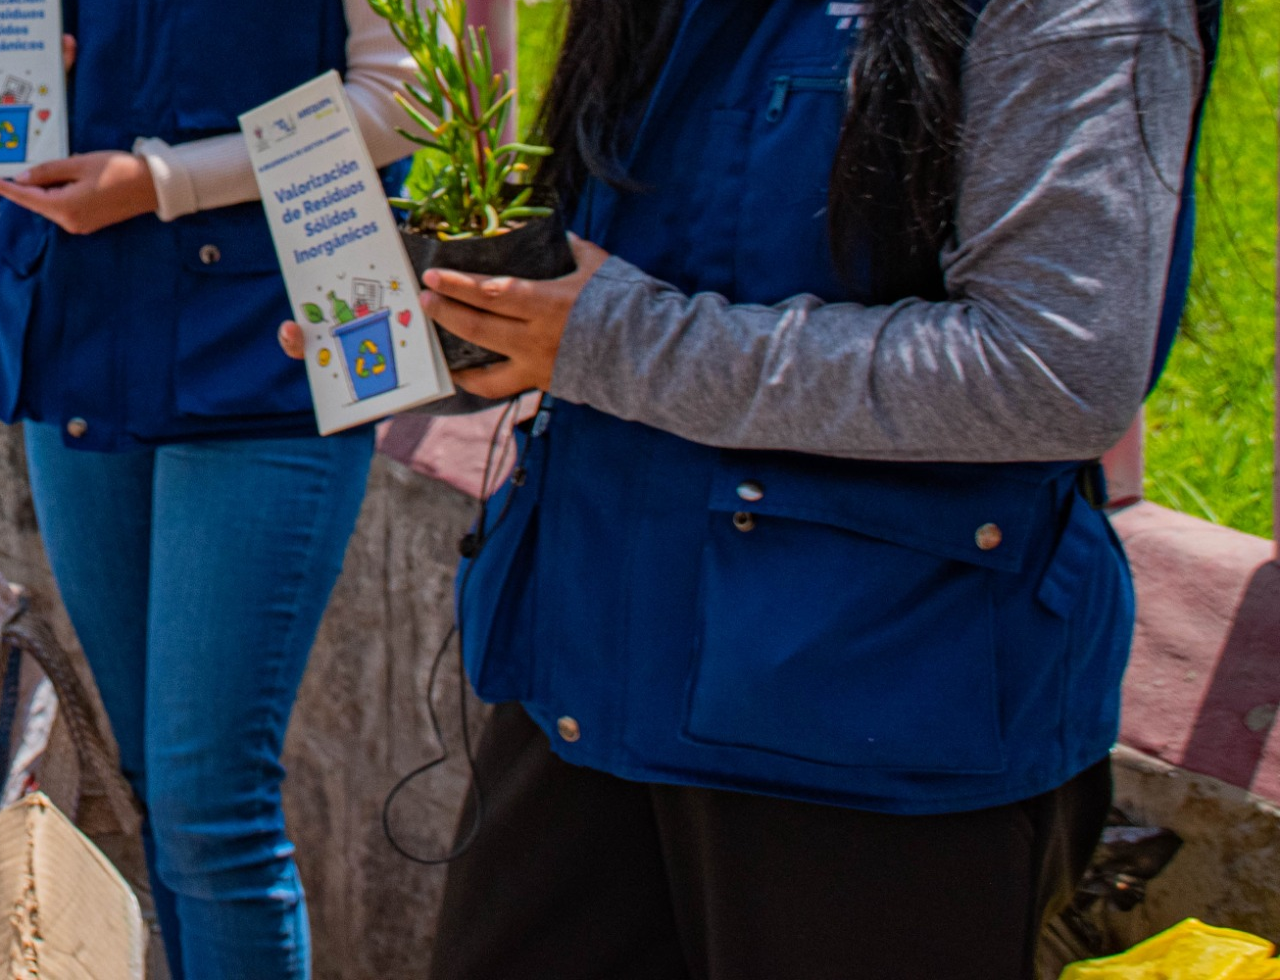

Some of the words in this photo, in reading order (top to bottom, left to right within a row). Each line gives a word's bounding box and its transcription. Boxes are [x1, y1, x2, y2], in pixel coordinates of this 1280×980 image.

[274, 159, 359, 203] Valorización
[282, 208, 301, 224] de
[303, 180, 365, 215] Residuos
[293, 221, 379, 264] Inorgánicos
[304, 207, 357, 237] Sólidos
